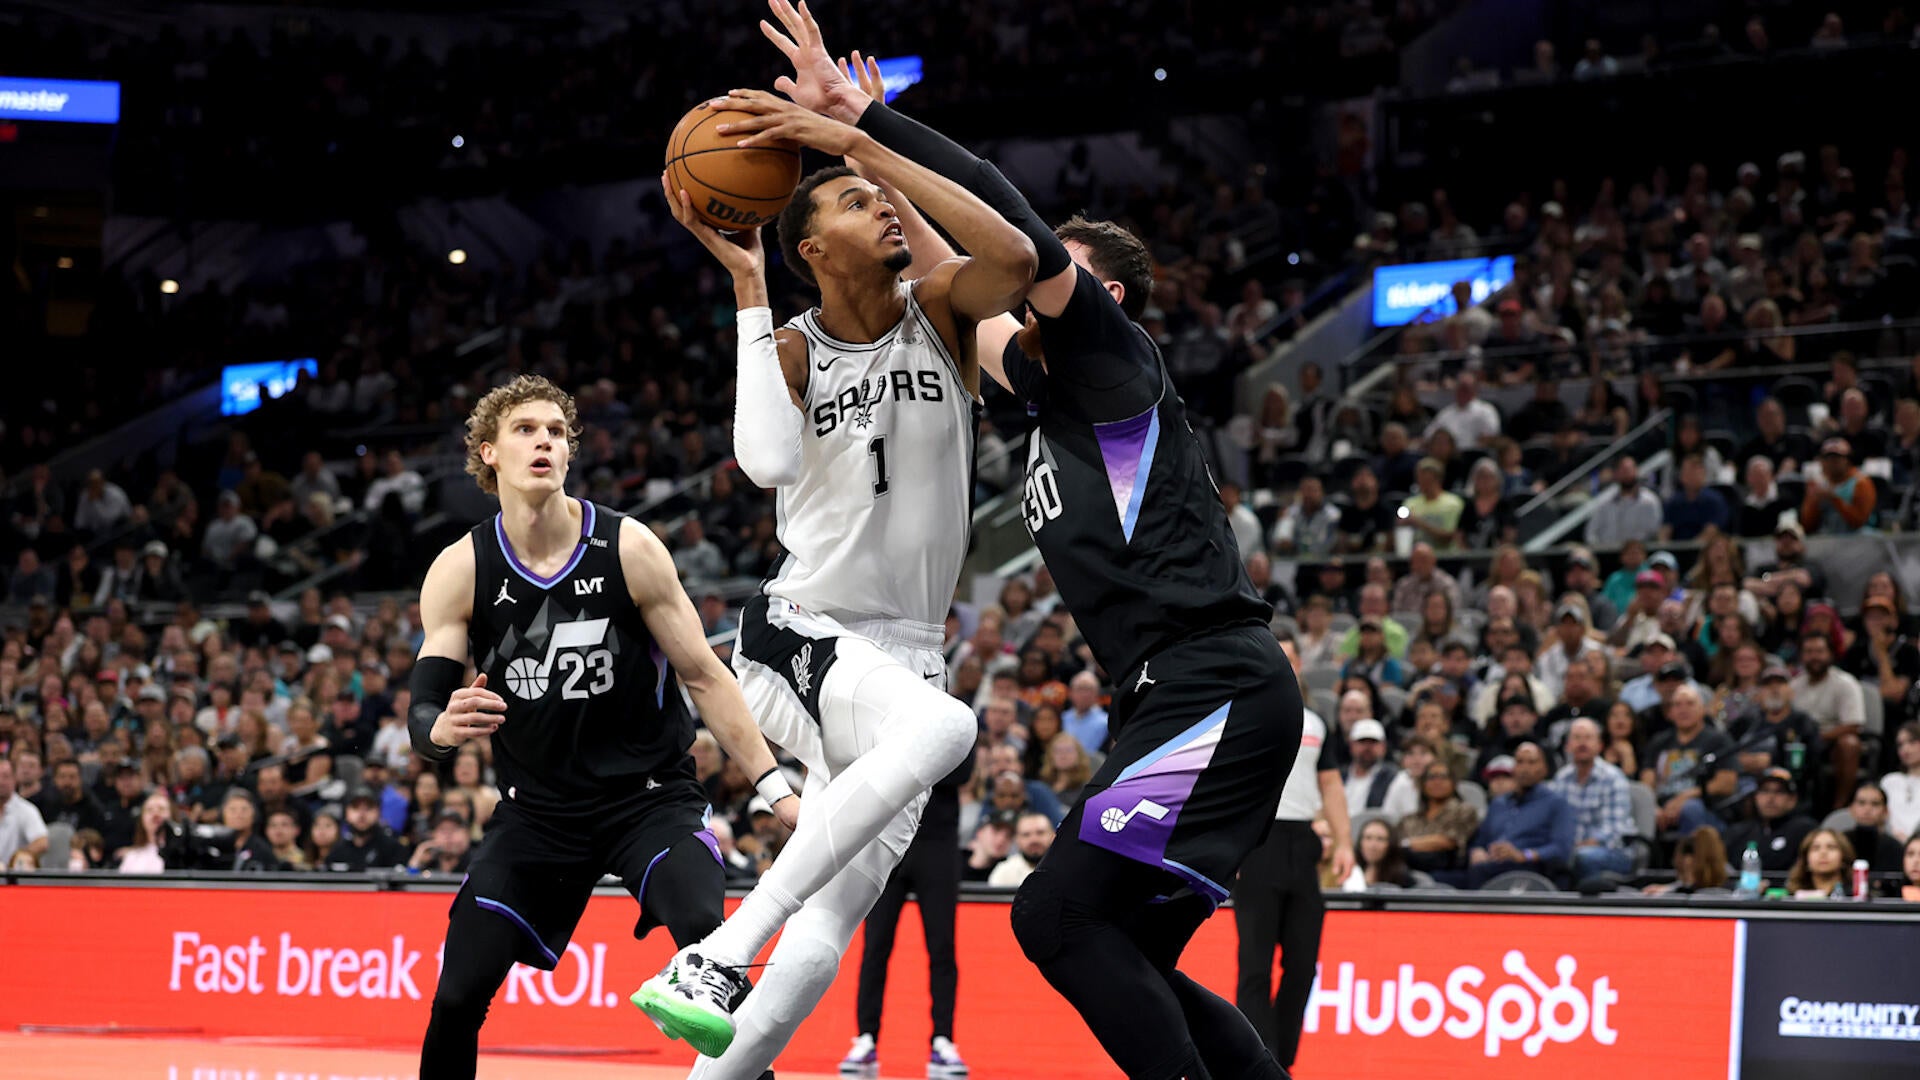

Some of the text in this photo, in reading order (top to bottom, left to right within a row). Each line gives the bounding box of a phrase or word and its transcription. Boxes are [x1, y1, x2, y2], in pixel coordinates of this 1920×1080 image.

[706, 196, 776, 225] Wils
[813, 370, 943, 438] SPURS
[867, 434, 890, 498] 1
[1025, 462, 1063, 533] 30
[574, 577, 604, 595] LVT
[557, 649, 614, 700] 23
[169, 930, 266, 995] Fast
[277, 932, 422, 1000] break
[505, 941, 618, 1008] ROI.
[1303, 949, 1618, 1058] HubSpot
